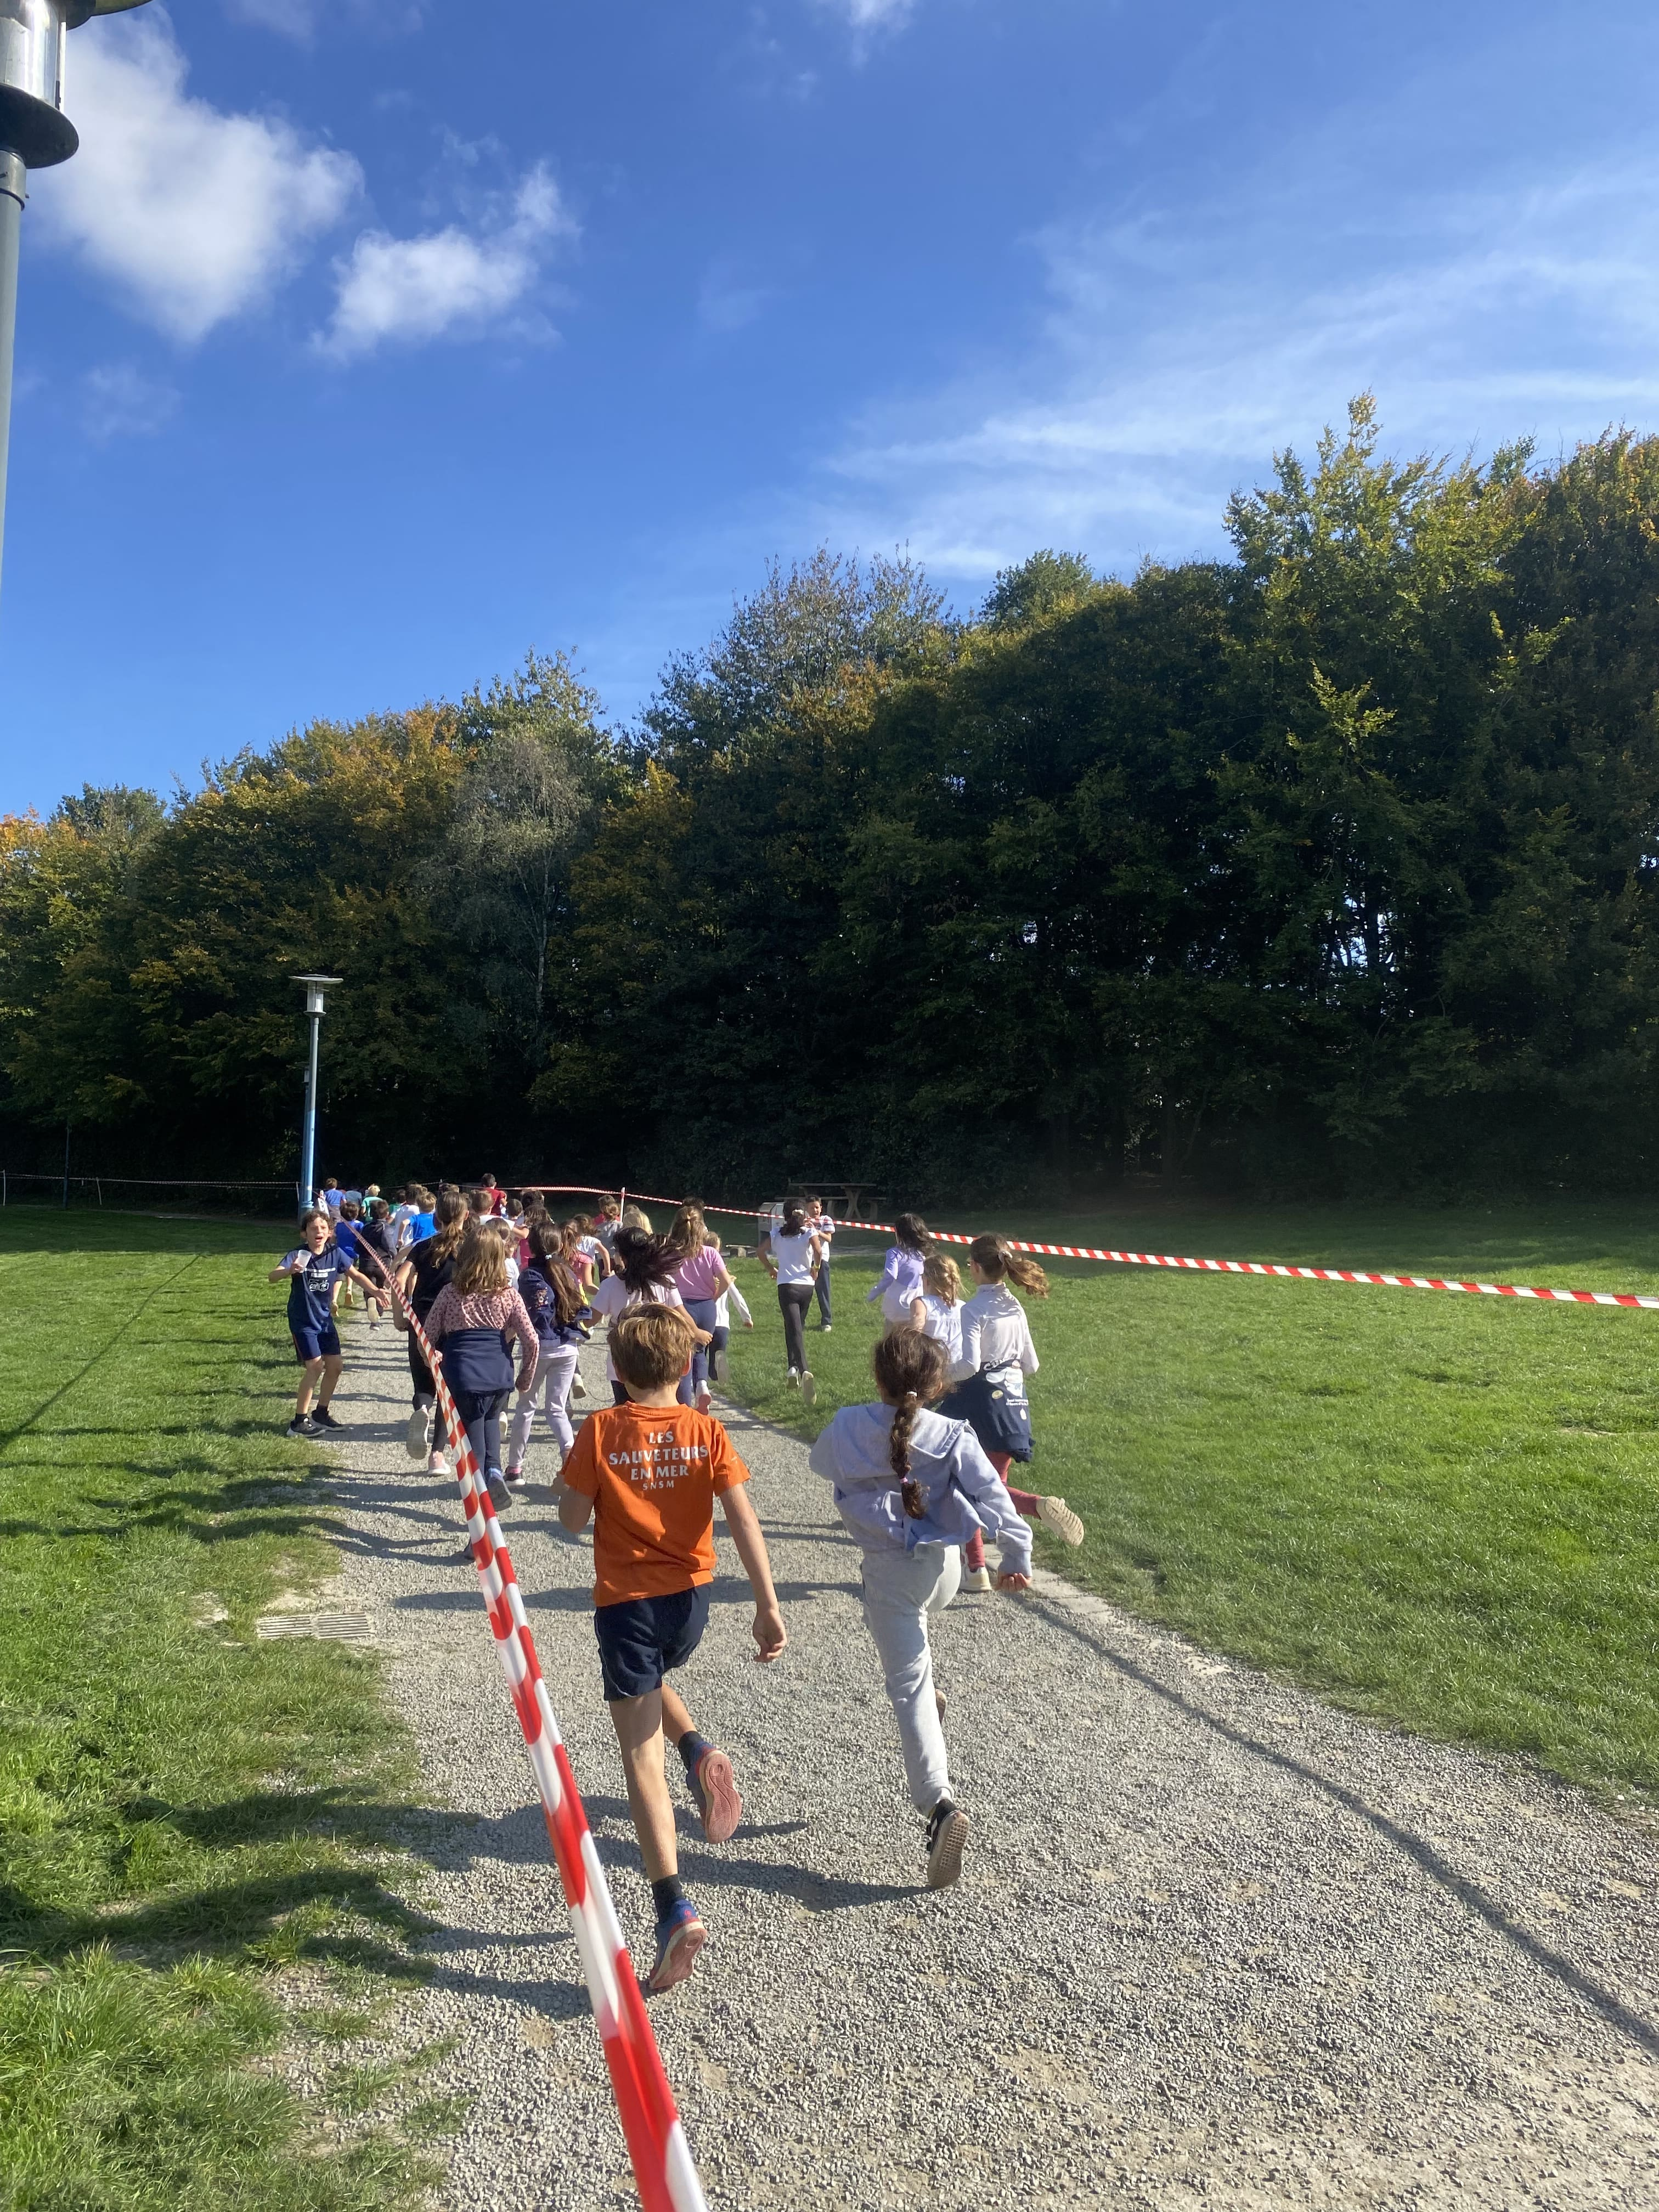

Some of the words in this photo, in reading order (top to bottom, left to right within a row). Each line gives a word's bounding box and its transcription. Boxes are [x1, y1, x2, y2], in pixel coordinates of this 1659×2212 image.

[649, 1431, 674, 1444] LES
[609, 1445, 709, 1465] SAUVETEURS
[631, 1466, 651, 1480] EN
[656, 1465, 689, 1479] MER
[642, 1480, 674, 1491] SNSM
